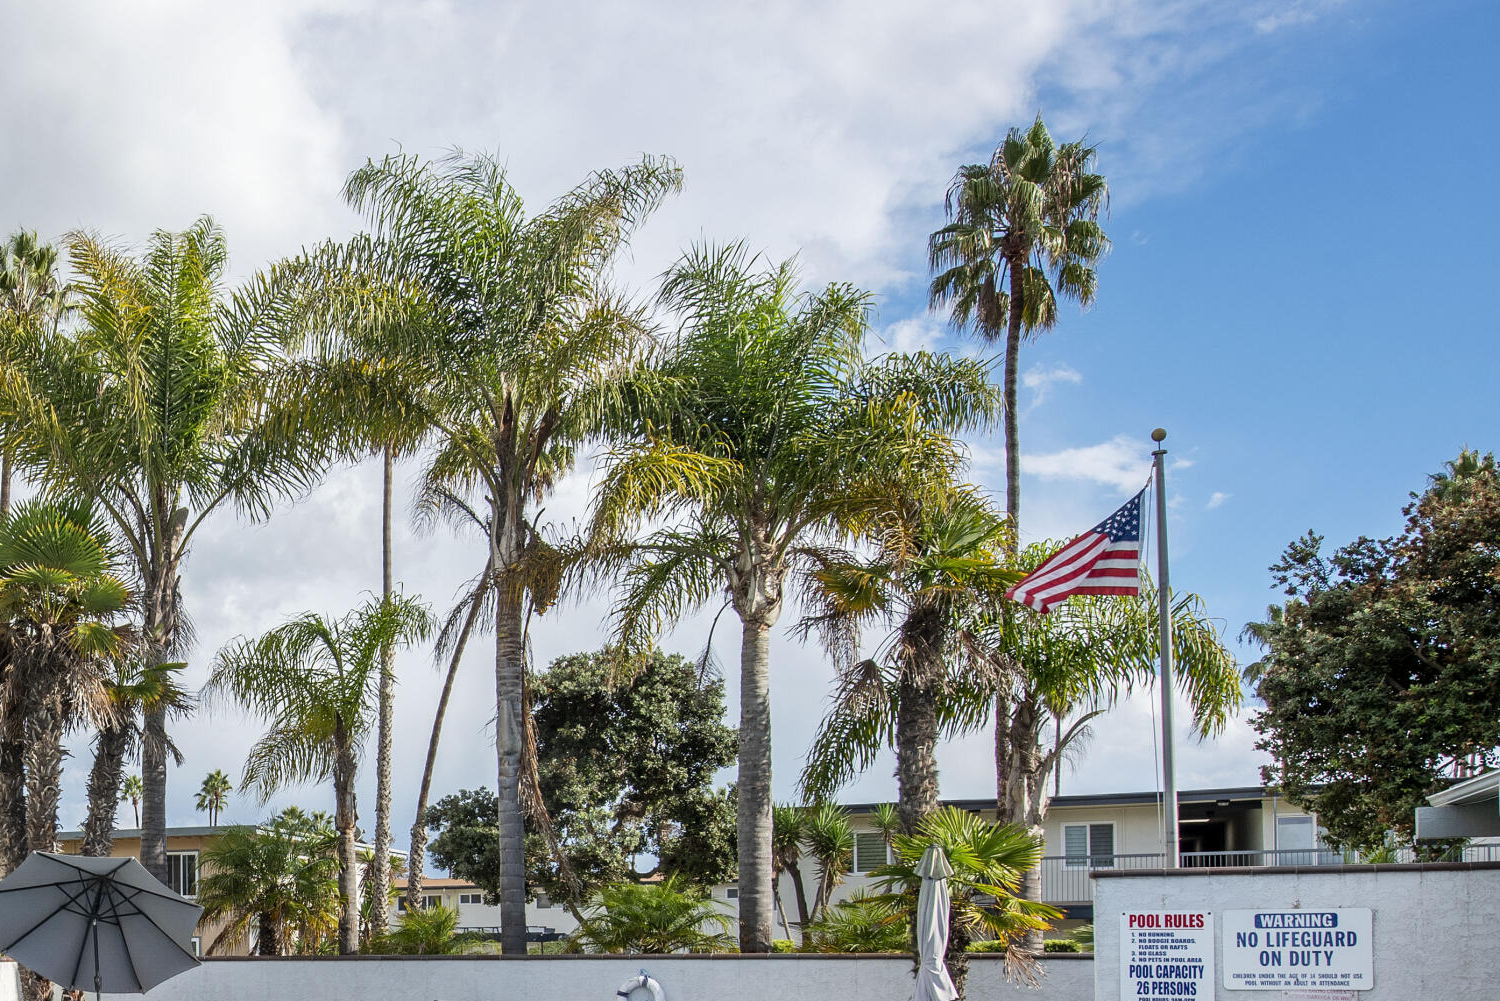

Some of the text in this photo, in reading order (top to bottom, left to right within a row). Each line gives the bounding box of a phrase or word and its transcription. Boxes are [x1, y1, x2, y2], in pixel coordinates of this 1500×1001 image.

[1129, 914, 1204, 928] POOL RULES
[1260, 914, 1332, 927] WARNING
[1237, 931, 1357, 947] NO LIFEGUARD
[1259, 951, 1334, 966] ON DUTY
[1130, 965, 1204, 979] POOL CAPACITY
[1137, 981, 1196, 995] 26 PERSONS
